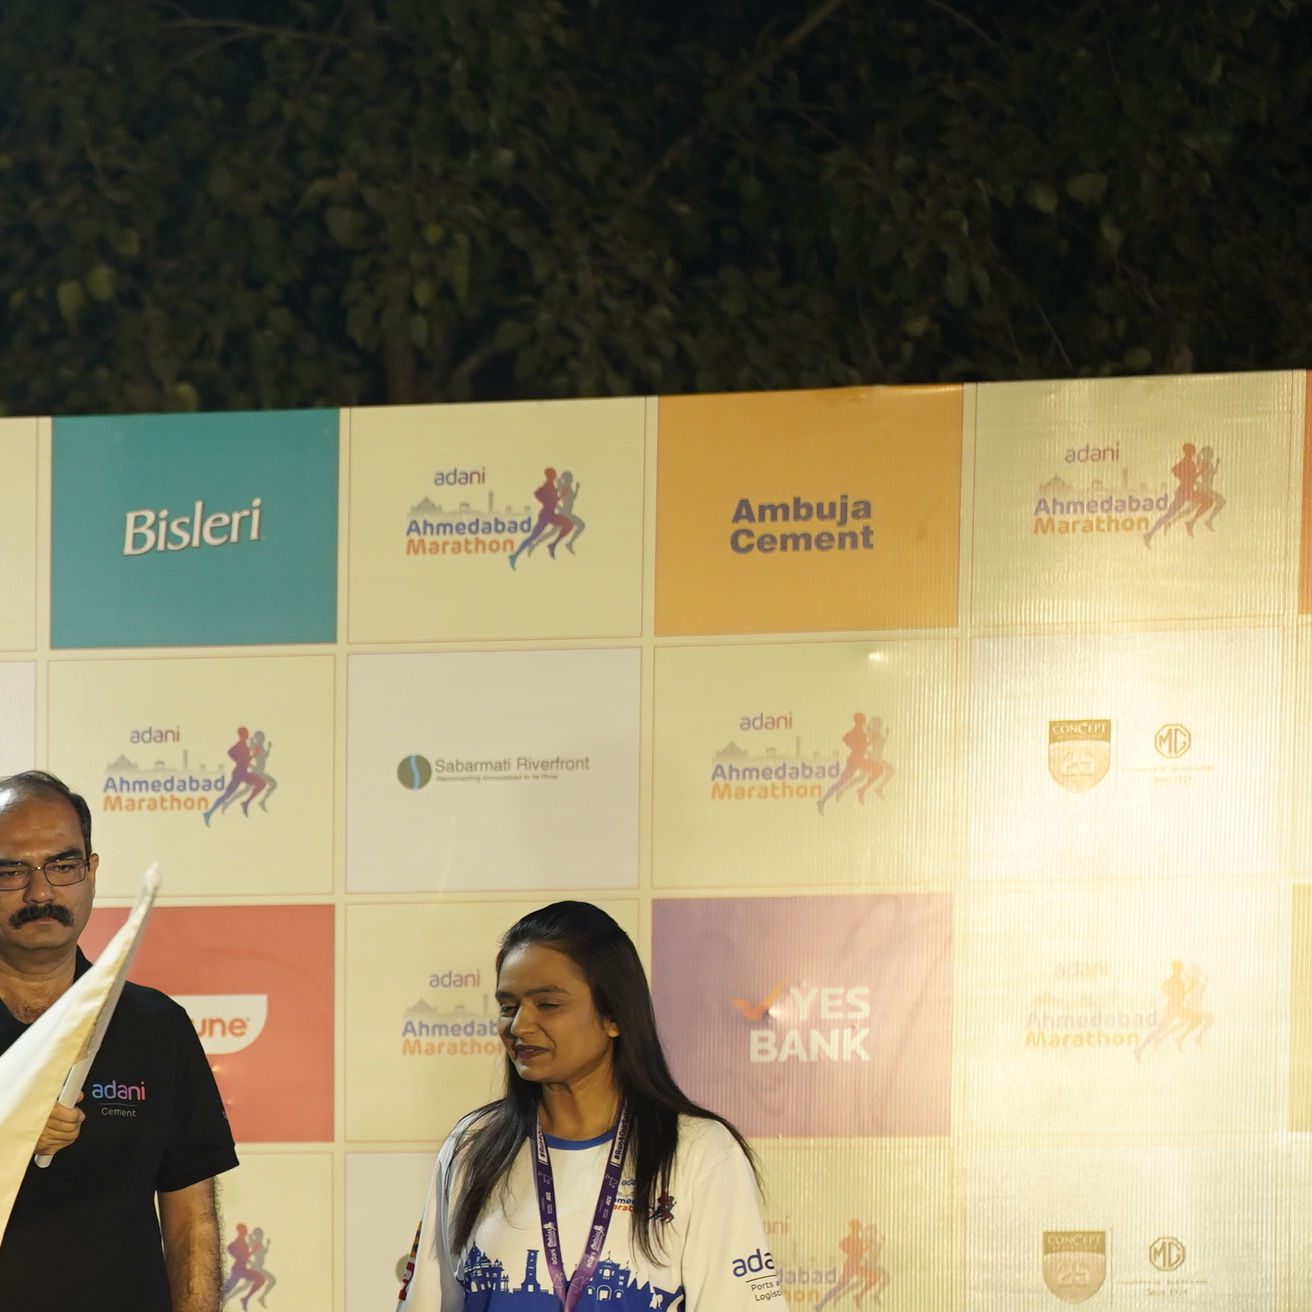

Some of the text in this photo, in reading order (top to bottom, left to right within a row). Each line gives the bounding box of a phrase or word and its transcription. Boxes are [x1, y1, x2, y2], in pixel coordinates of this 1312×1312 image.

[1064, 443, 1120, 464] adani
[434, 468, 486, 486] adani
[732, 495, 873, 528] Ambuja
[1034, 495, 1169, 516] Ahmedabad
[123, 498, 262, 558] Bisleri
[406, 517, 532, 536] Ahmedabad
[1033, 514, 1150, 535] Marathon
[406, 536, 515, 556] Marathon
[730, 525, 874, 555] Cement
[740, 713, 792, 731] adani
[130, 726, 180, 745] adani
[1159, 728, 1187, 754] MG
[435, 756, 590, 773] Sabarmati Riverfront
[712, 762, 840, 781] Ahmedabad
[104, 776, 226, 794] Ahmedabad
[712, 781, 821, 800] Marathon
[104, 794, 209, 813] Marathon
[429, 969, 480, 988] adani
[791, 986, 871, 1020] YES
[402, 1020, 499, 1037] Ahmedab
[1025, 1009, 1157, 1029] Ahmedabad
[750, 1028, 871, 1064] BANK
[1026, 1030, 1140, 1047] Marathon
[92, 1080, 146, 1100] adani
[101, 1107, 136, 1117] Cement
[1154, 1241, 1182, 1267] MG
[751, 1281, 774, 1291] Ports
